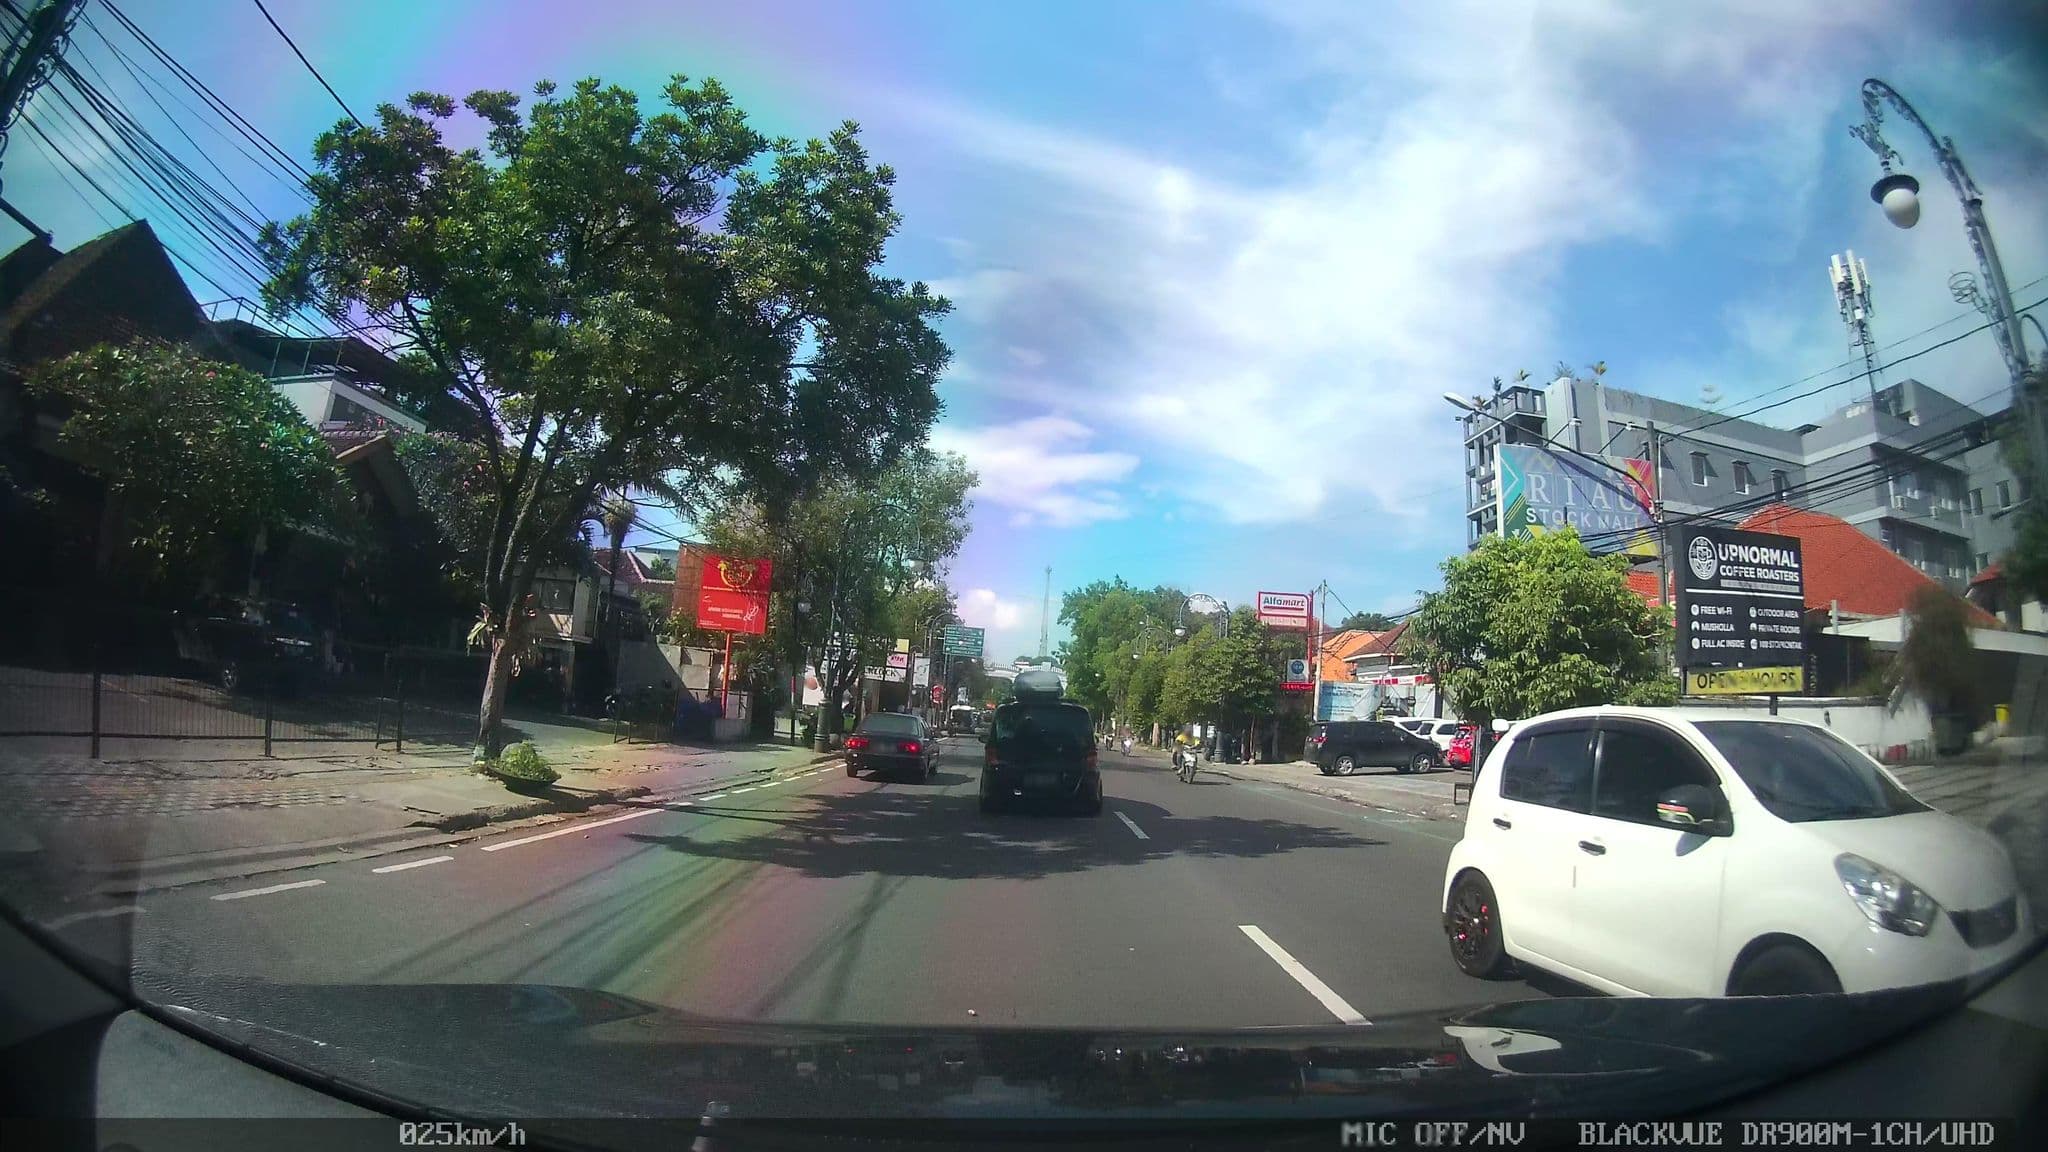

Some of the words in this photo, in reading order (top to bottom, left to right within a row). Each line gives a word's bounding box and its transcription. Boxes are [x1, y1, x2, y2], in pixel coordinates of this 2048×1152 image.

[1528, 473, 1637, 512] RIAU
[1526, 507, 1592, 528] STOCK
[1598, 513, 1640, 529] MALL
[1718, 543, 1799, 568] UPNORMAL
[1720, 565, 1755, 579] COFFEE
[1756, 568, 1799, 582] ROASTERS
[1263, 596, 1305, 607] Alfamart
[1700, 606, 1716, 615] FREE
[1757, 608, 1784, 618] OUTDOOR
[1784, 610, 1799, 619] AREA
[1701, 623, 1735, 632] MUSHOLLA
[1758, 624, 1780, 633] PRIVATE
[1701, 639, 1716, 648] FULL
[1716, 640, 1725, 648] AC
[1726, 640, 1745, 648] INSIDE
